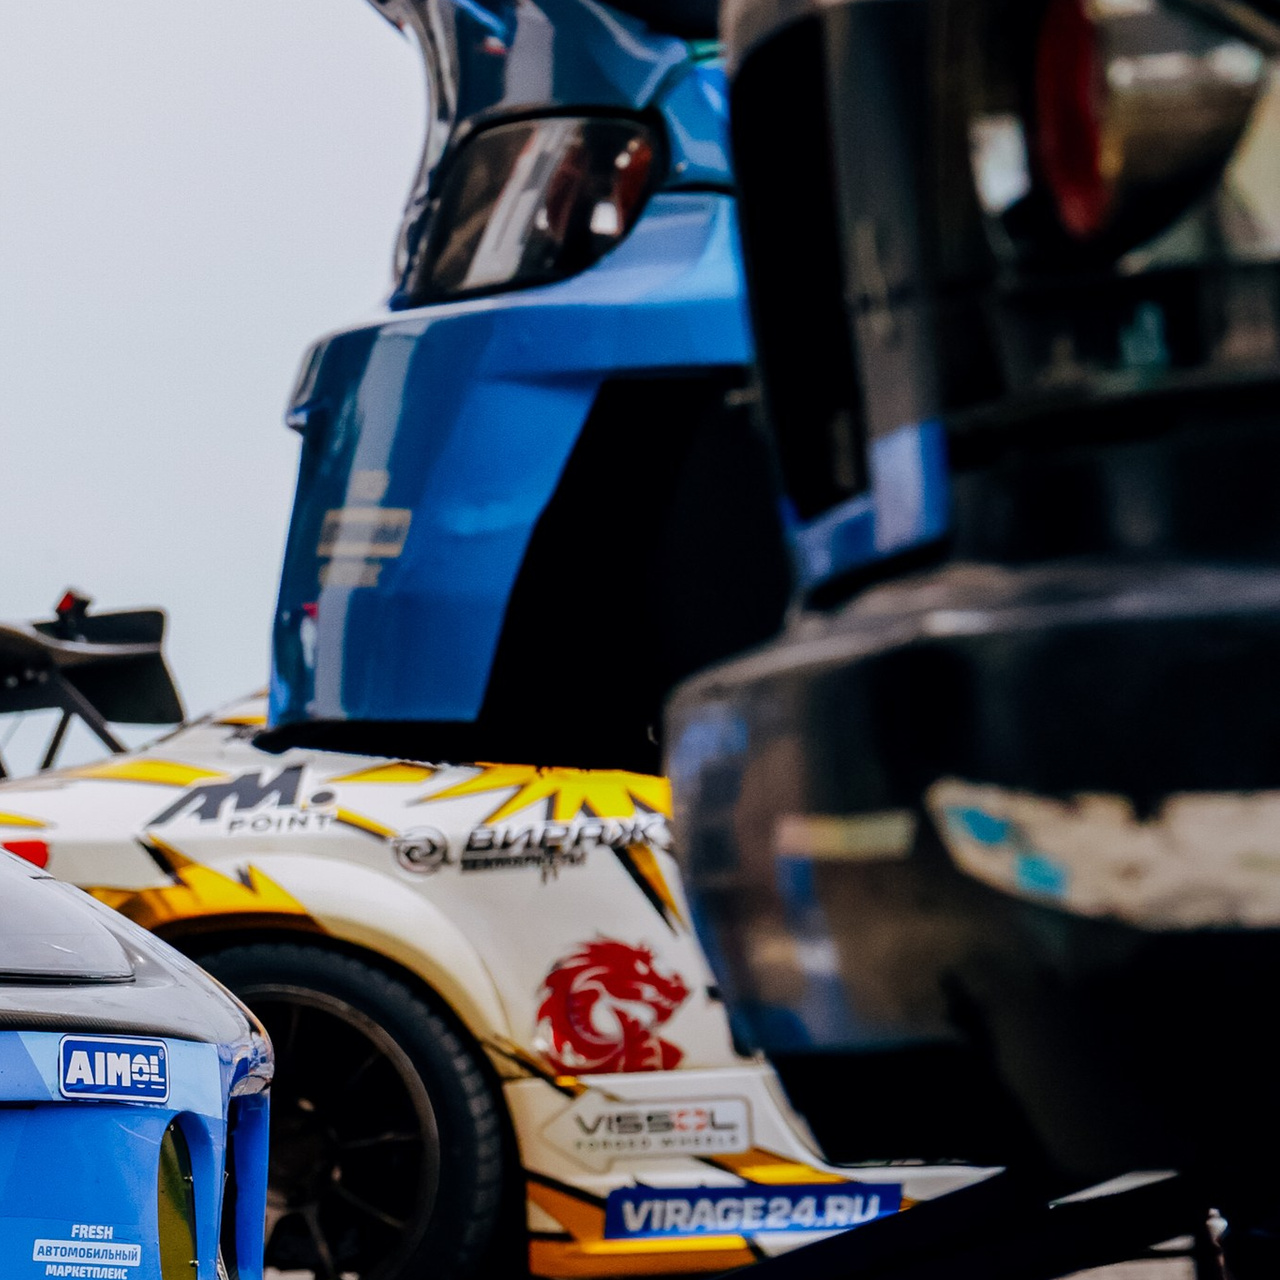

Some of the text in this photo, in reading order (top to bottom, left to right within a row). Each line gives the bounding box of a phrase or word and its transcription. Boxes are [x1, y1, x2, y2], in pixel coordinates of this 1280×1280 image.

[228, 813, 337, 835] POINT
[65, 1050, 165, 1089] AIMOL
[575, 1109, 738, 1135] VISSOL
[621, 1194, 880, 1232] VIRAGE24.RU
[71, 1224, 114, 1239] FRESH
[37, 1246, 138, 1261] АВТОМОБИЛЬНЫЙ
